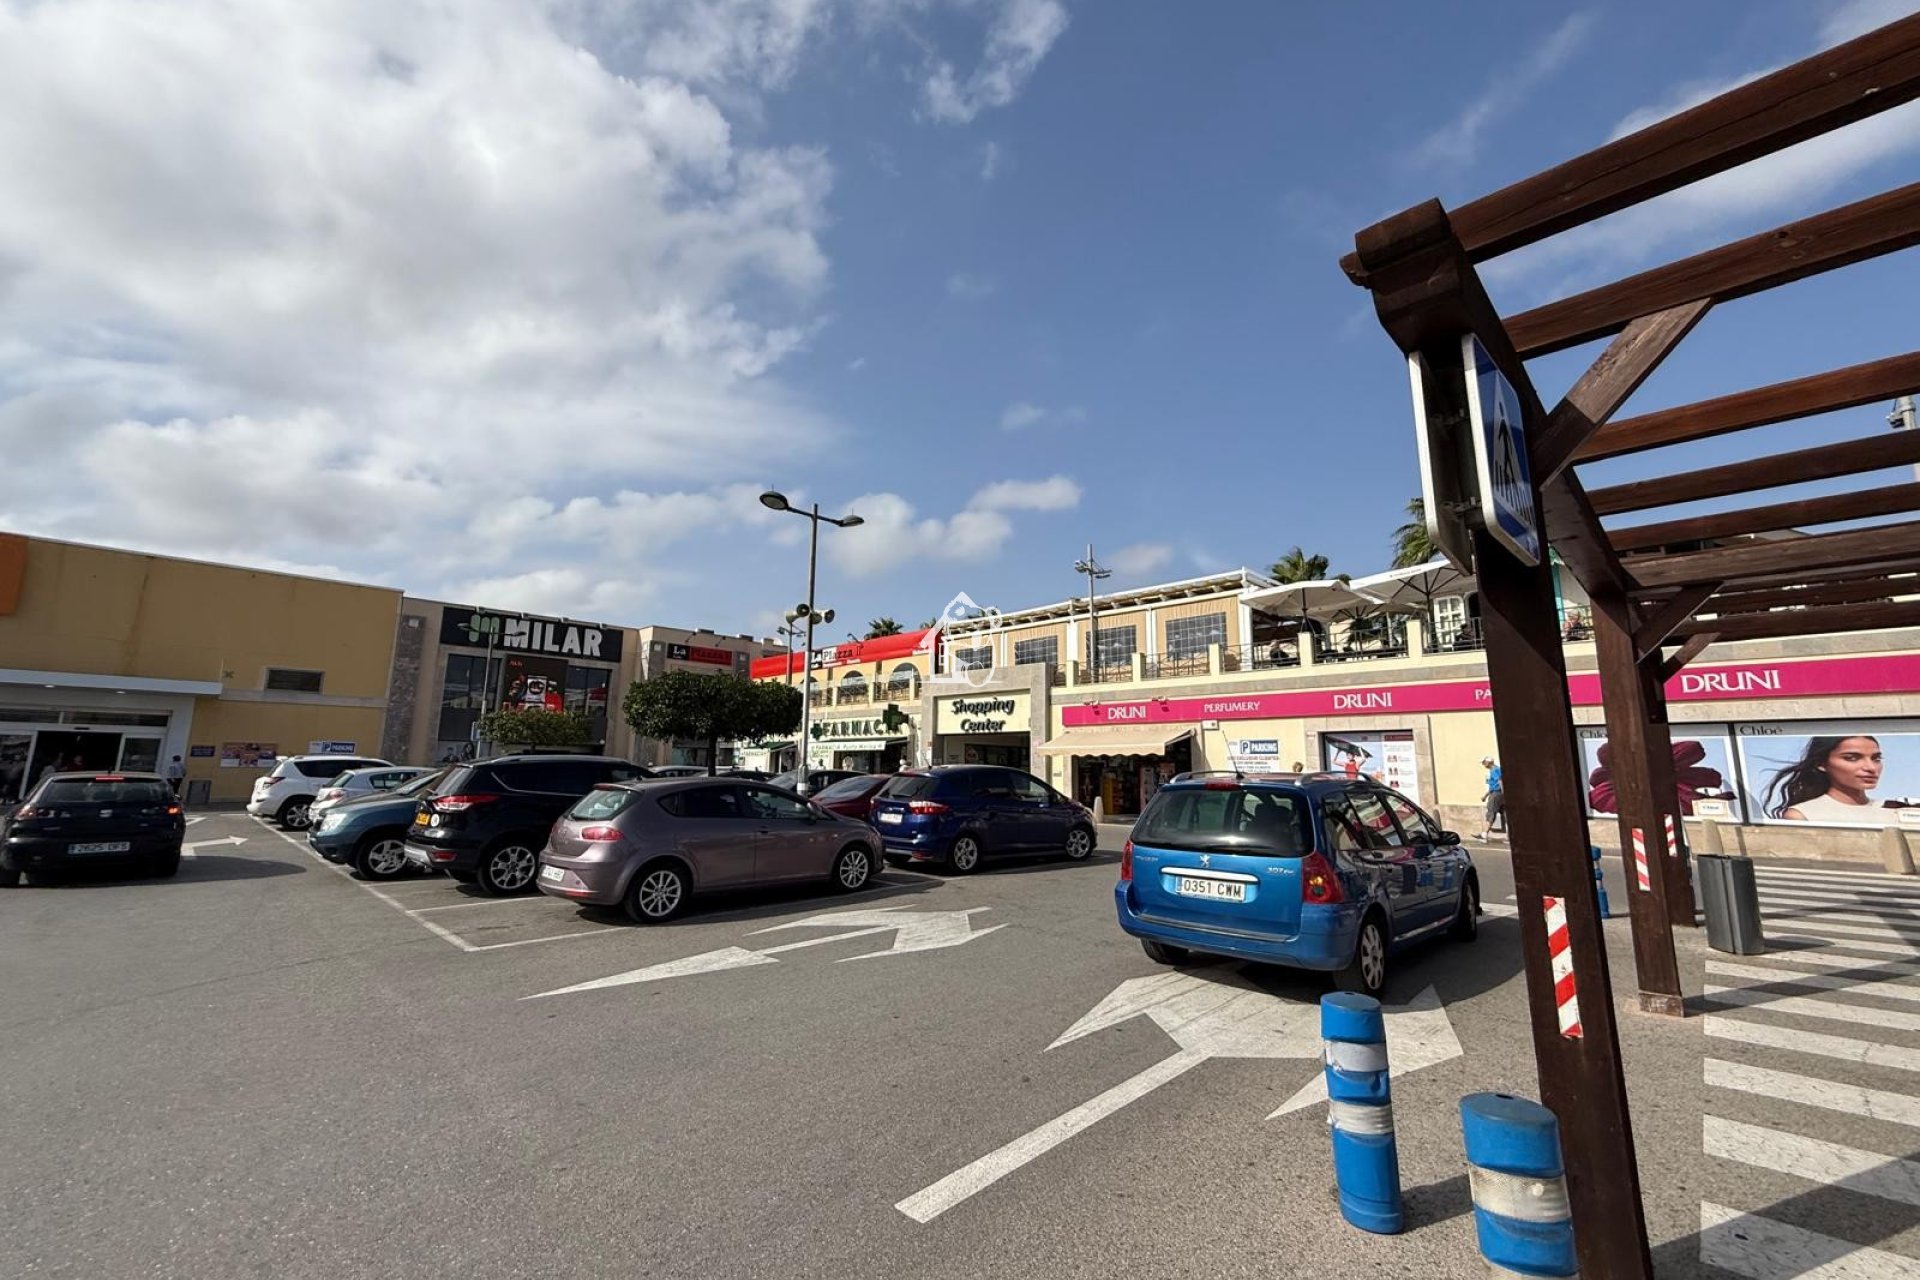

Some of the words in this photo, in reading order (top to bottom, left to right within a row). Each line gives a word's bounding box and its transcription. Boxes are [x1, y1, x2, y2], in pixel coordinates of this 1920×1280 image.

[503, 618, 602, 657] MILAR
[1680, 669, 1782, 693] DRUNI
[951, 697, 1015, 717] Shopping
[1107, 705, 1147, 720] DRUNI
[1204, 701, 1260, 713] PERFUMERY
[1333, 692, 1393, 709] DRUNI
[960, 718, 1006, 732] Center
[1183, 879, 1212, 894] 0351
[1217, 884, 1242, 897] CWM
